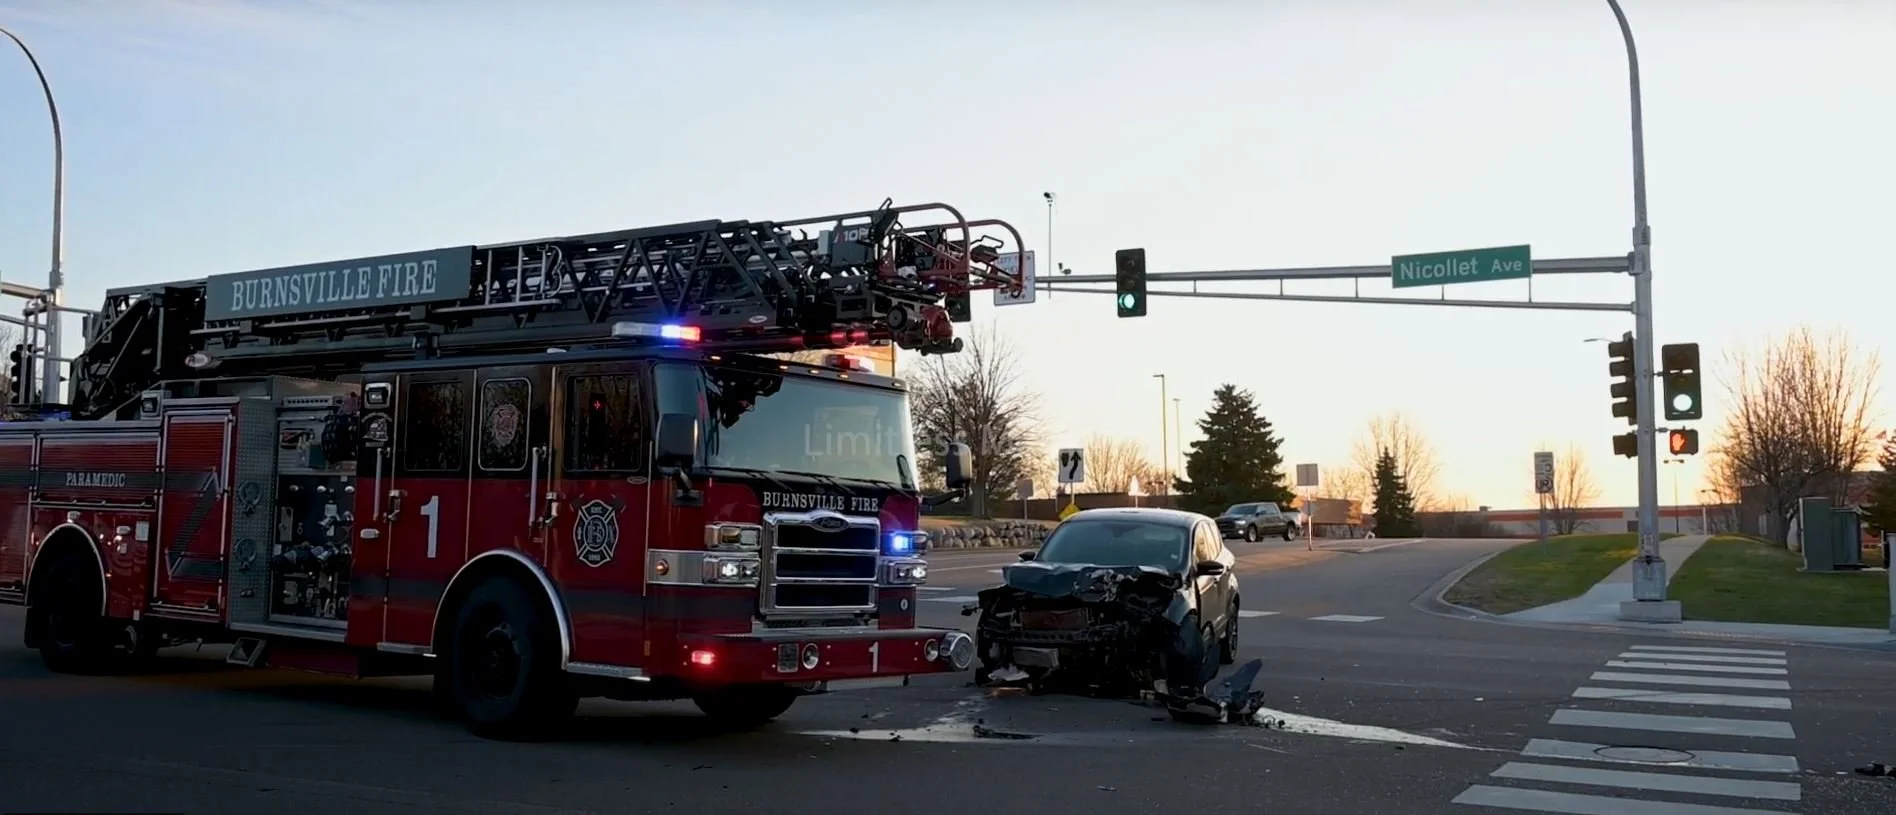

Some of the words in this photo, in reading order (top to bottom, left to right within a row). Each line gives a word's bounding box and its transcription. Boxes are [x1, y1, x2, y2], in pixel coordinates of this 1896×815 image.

[1400, 257, 1479, 280] Nicollet
[1491, 259, 1523, 273] Ave
[231, 266, 371, 311] BURNSVILLE
[376, 260, 437, 298] FIRE
[65, 472, 126, 487] PARAMEDIC
[763, 491, 845, 511] BURNSVILLE
[850, 496, 879, 512] FIRE
[420, 495, 439, 559] 1
[868, 640, 879, 673] 1
